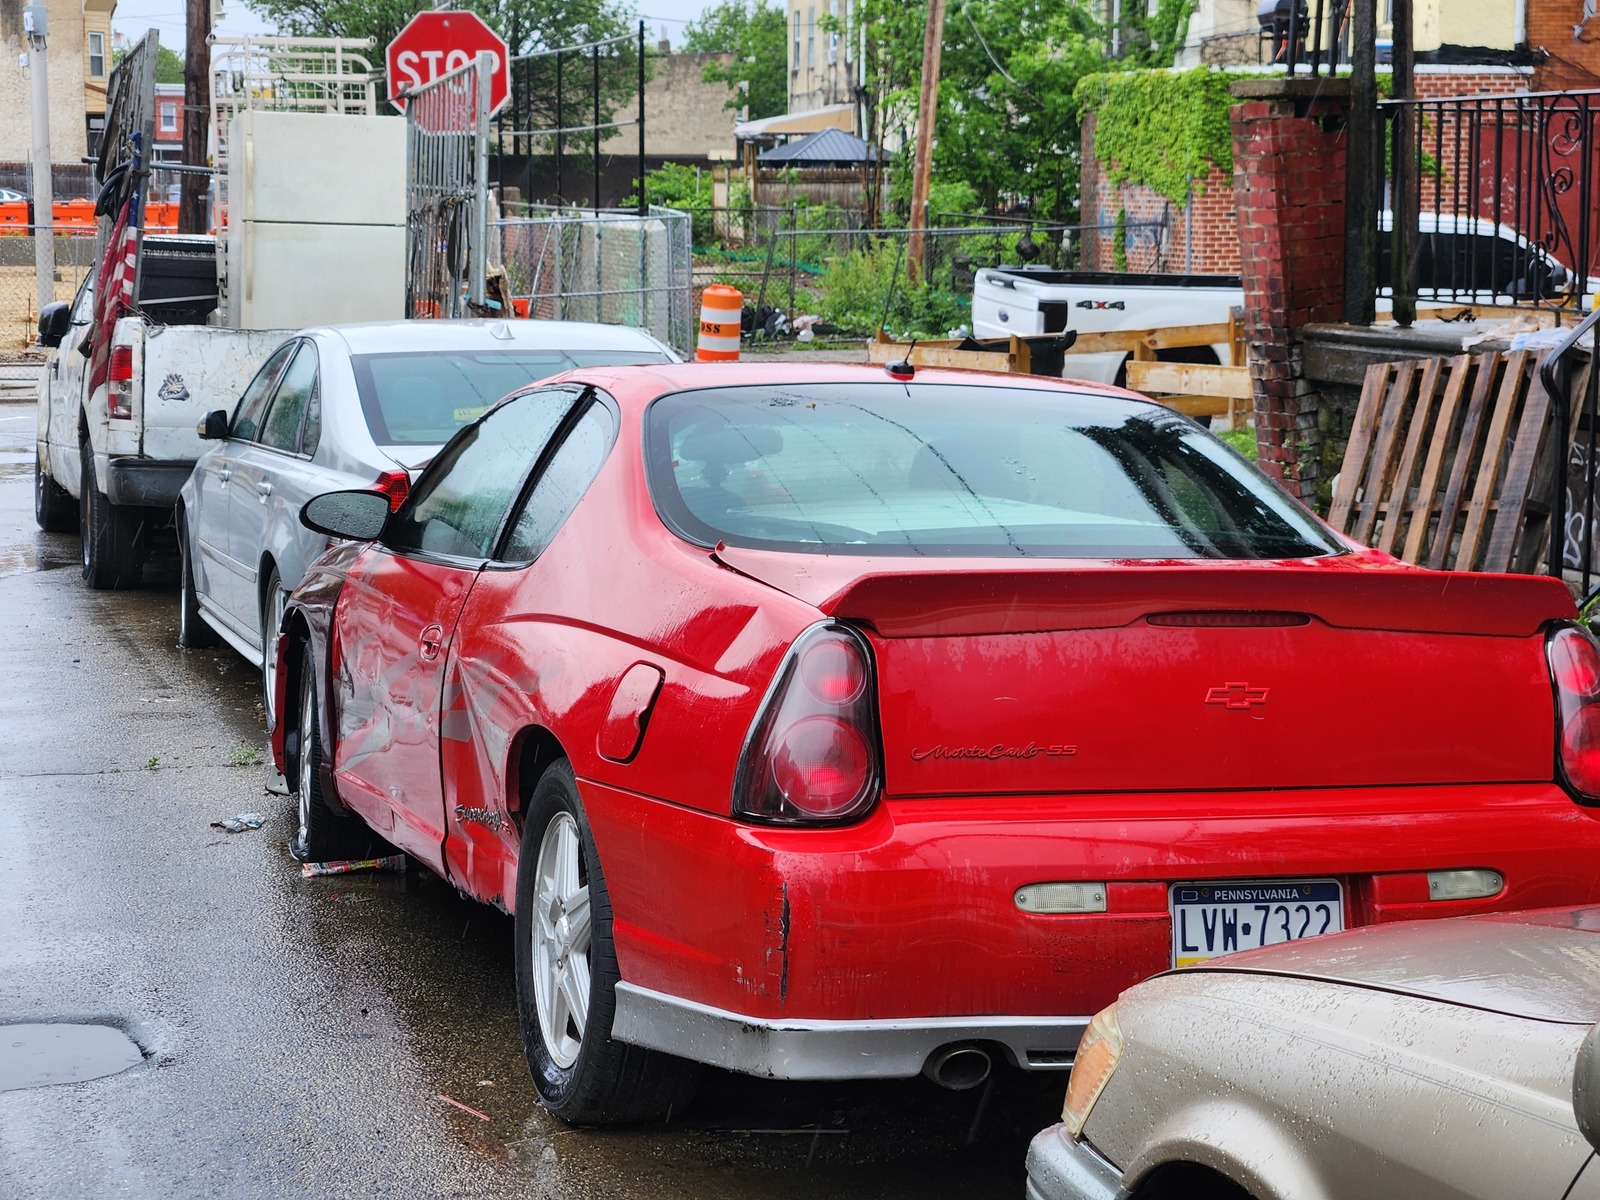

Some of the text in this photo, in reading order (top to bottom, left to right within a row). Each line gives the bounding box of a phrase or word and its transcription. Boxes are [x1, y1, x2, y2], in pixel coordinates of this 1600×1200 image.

[396, 49, 500, 95] STOP
[1047, 744, 1078, 756] SS
[1214, 888, 1300, 901] PENNSYLVANIA
